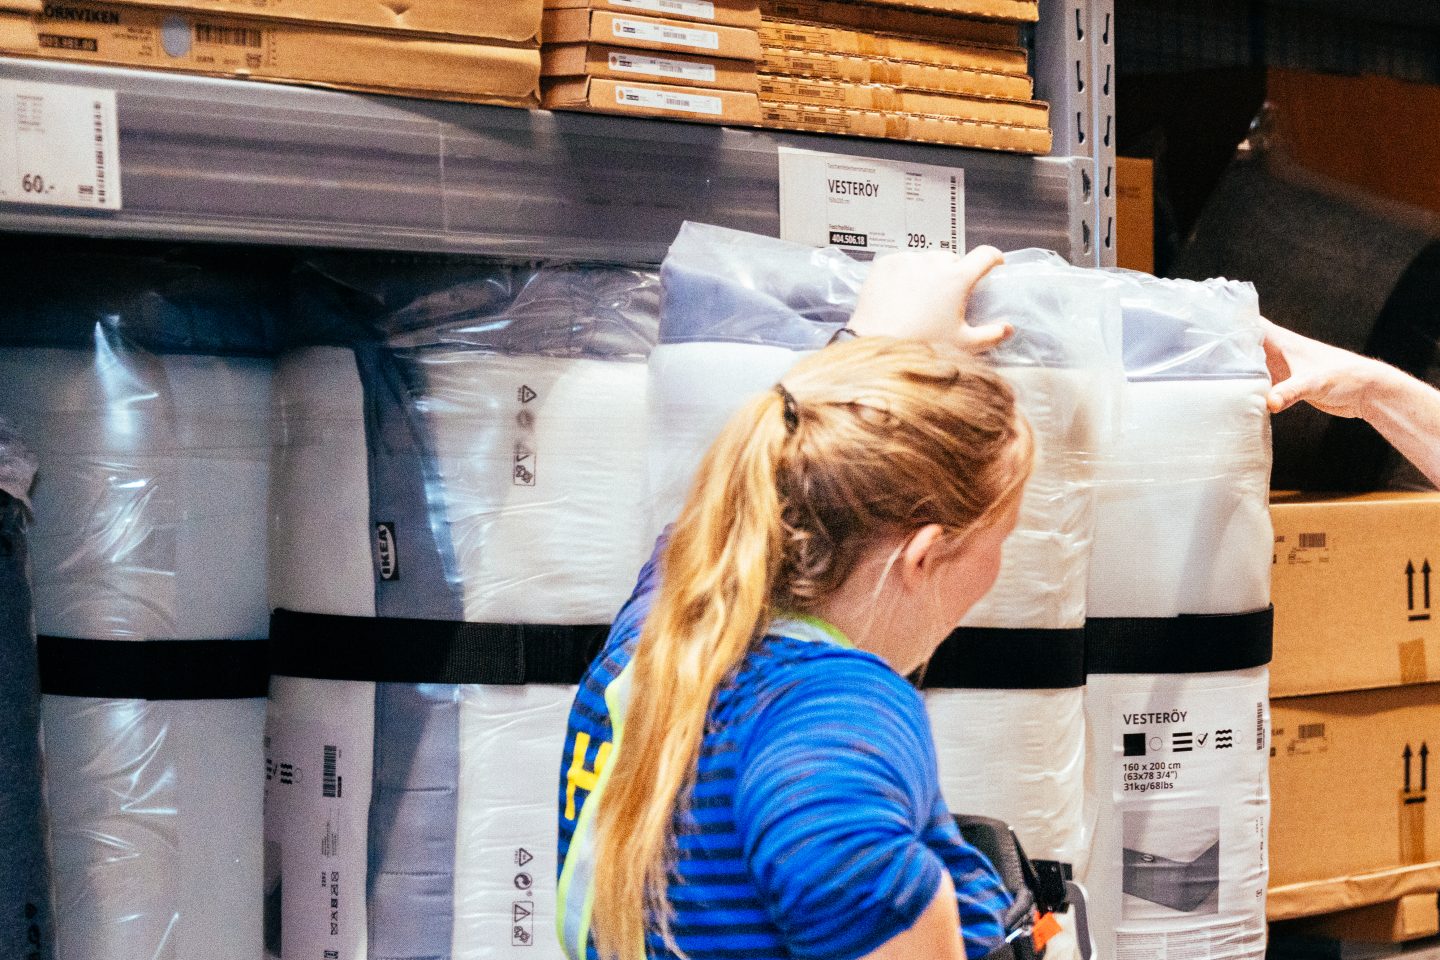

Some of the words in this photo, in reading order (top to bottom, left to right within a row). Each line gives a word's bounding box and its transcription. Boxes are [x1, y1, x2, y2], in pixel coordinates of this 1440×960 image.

[828, 179, 879, 198] VESTERÖY
[907, 233, 933, 249] 299.-
[377, 527, 392, 577] IKEA
[1123, 709, 1187, 725] VESTERÖY
[1123, 763, 1139, 771] 160
[1150, 762, 1165, 770] 200
[1168, 761, 1181, 770] cm
[1123, 772, 1154, 782] (63x78
[1123, 781, 1174, 793] 31kg/68lbs
